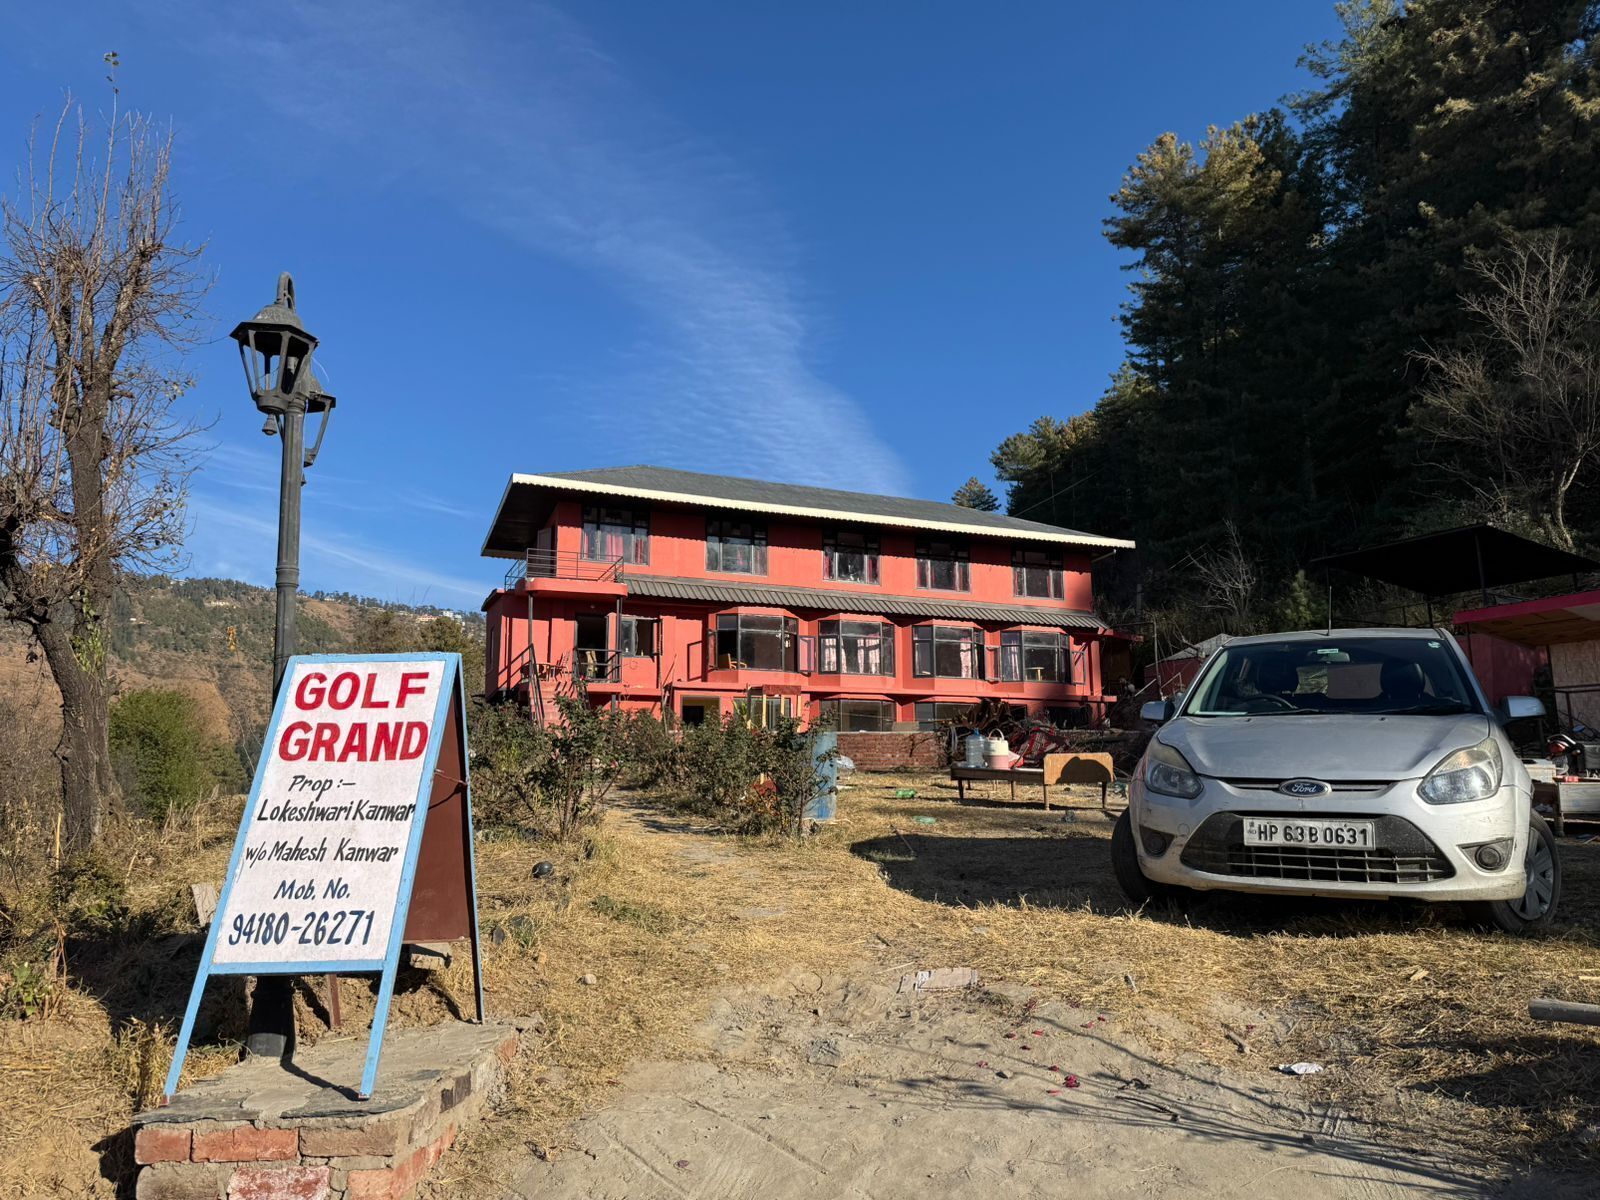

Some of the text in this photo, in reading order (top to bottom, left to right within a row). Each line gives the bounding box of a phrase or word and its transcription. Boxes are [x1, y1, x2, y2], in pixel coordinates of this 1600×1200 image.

[294, 671, 429, 711] GOLF
[278, 721, 429, 763] GRAND
[1291, 783, 1317, 793] Ford
[256, 798, 416, 822] Lokeshwari Kanwar
[1258, 824, 1368, 846] HP 63 B 0631
[245, 836, 399, 869] w/o Mahesh Kanwar
[273, 877, 351, 900] Mob. No.
[228, 910, 375, 946] 94180-26271
